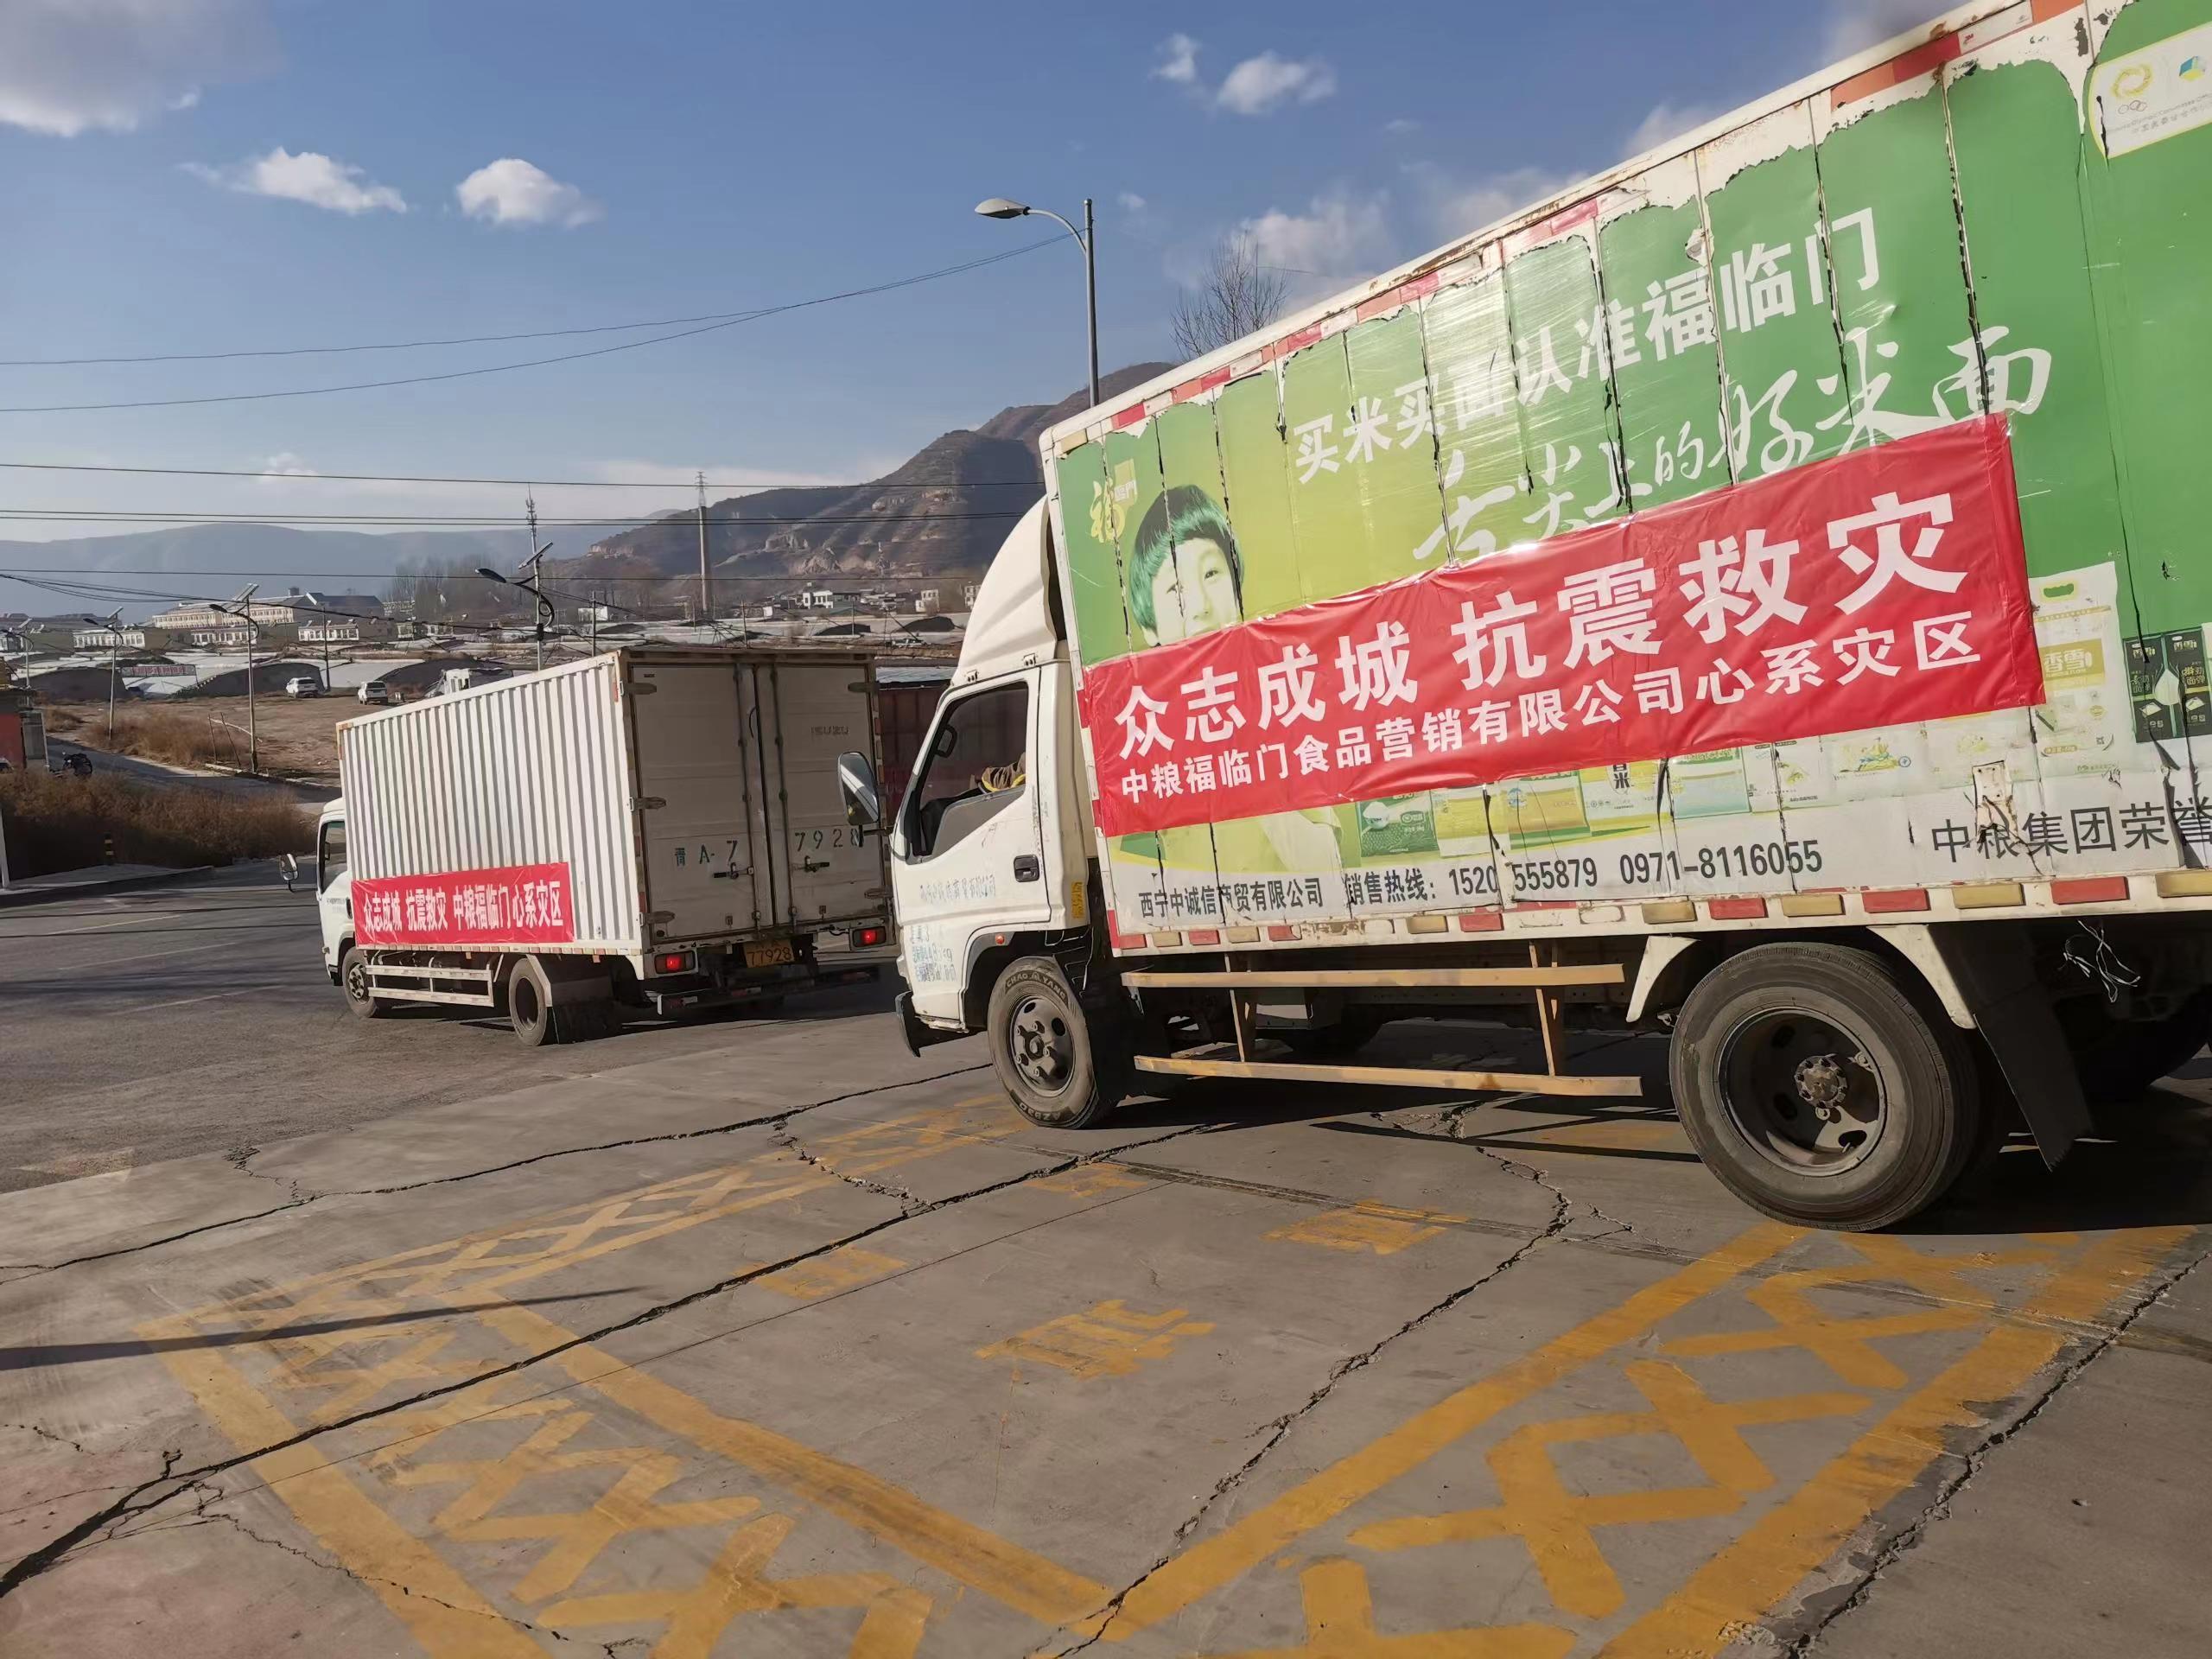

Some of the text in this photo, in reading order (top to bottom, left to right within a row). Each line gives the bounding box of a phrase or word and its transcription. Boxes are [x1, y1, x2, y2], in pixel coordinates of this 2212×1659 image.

[1294, 207, 1880, 484] 买米买面认准福临门
[1115, 493, 1969, 760] 众志成城 抗震救灾
[1122, 611, 1981, 804] 中粮福临门食品营销有限公司心系灾区
[1620, 840, 1822, 884] 0971-8116055
[364, 890, 403, 932] 众志成城
[406, 887, 448, 931] 抗震救灾
[747, 946, 792, 966] 77928
[1006, 973, 1067, 999] CHAO YANG
